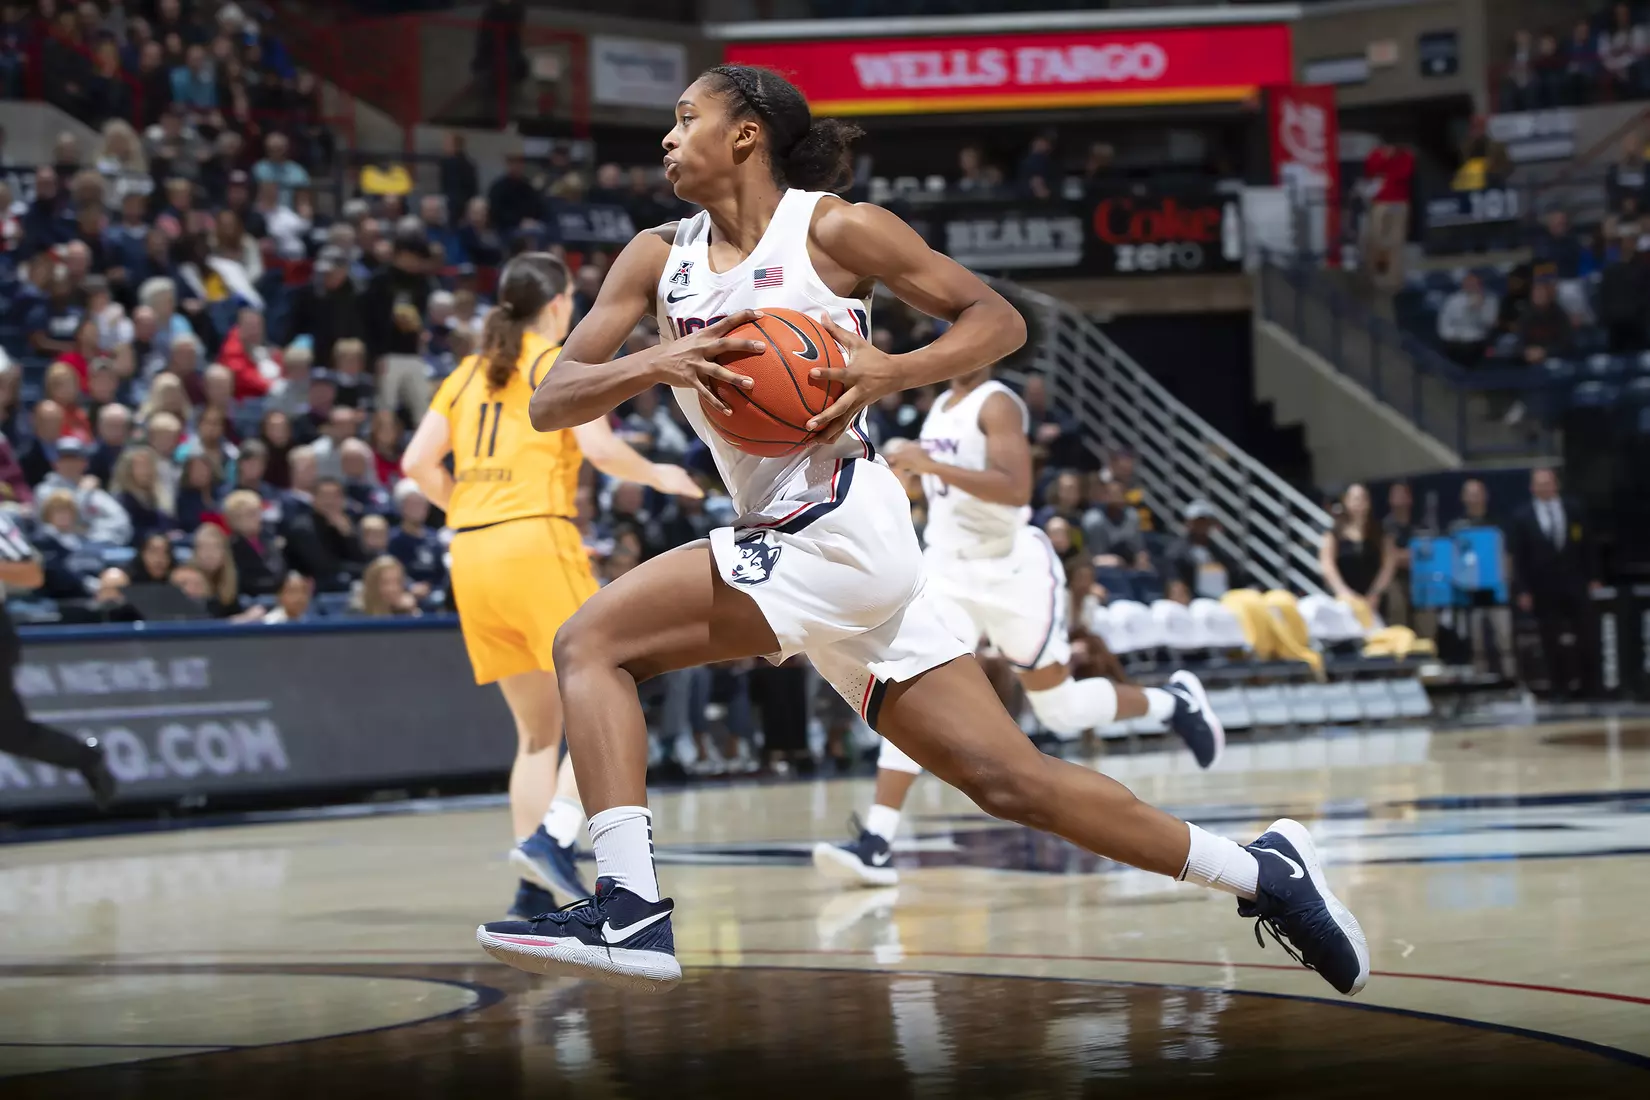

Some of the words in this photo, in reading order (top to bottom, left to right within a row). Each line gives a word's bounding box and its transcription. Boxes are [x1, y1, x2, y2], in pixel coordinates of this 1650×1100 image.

[853, 48, 1008, 89] WELLS
[1015, 43, 1168, 84] FARGO
[1093, 199, 1220, 244] Coke
[1115, 243, 1203, 272] zero
[474, 402, 503, 458] 11
